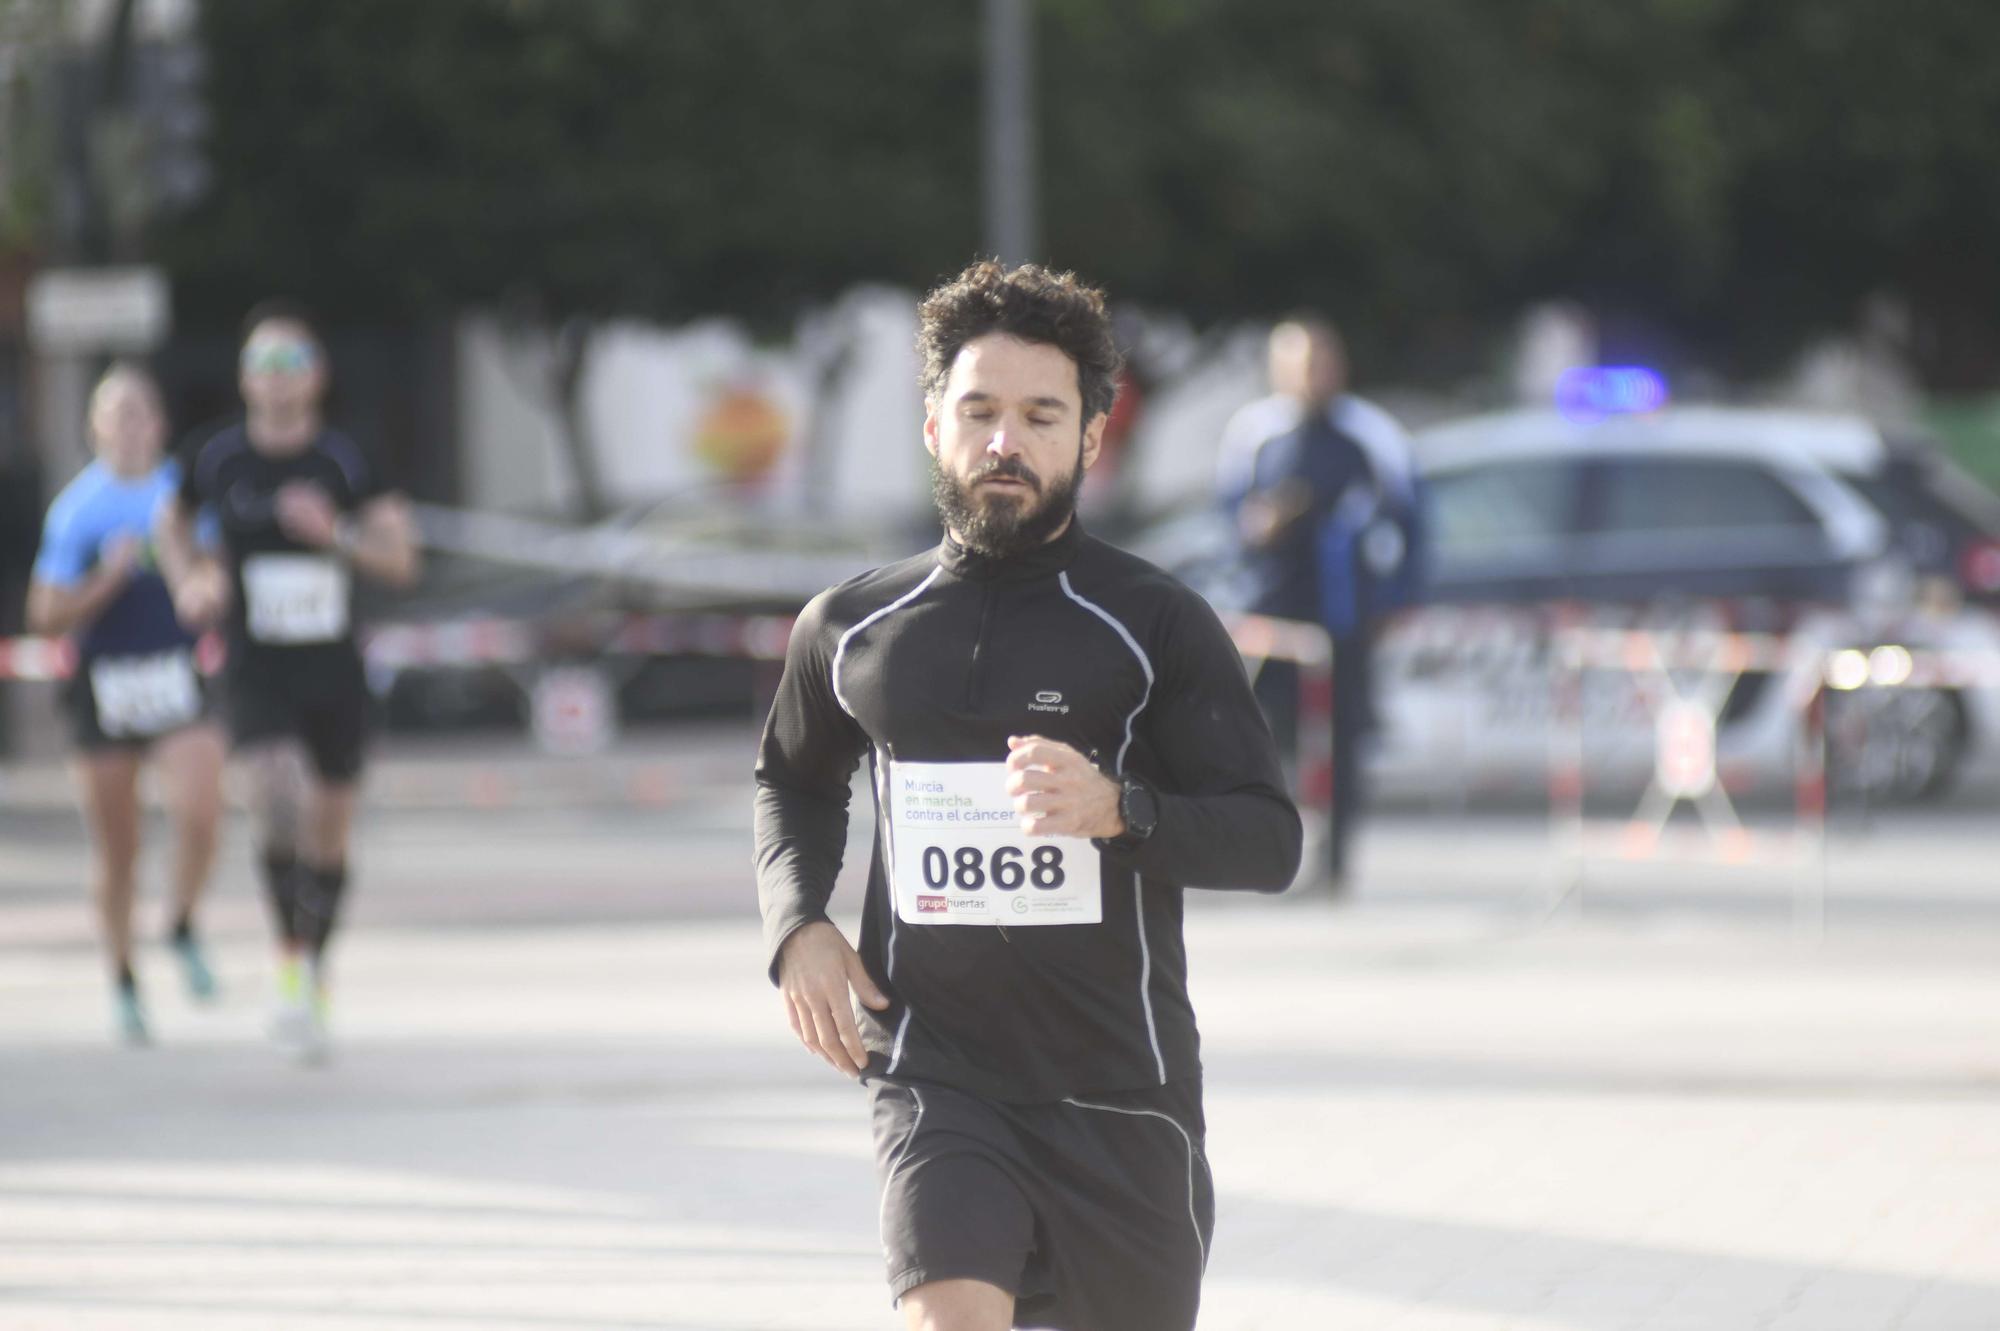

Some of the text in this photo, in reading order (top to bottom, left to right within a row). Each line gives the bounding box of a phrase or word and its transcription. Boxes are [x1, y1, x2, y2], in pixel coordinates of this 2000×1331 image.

[905, 778, 944, 793] Murcia
[905, 794, 973, 807] en marcha
[905, 808, 1016, 822] contra el cáncer
[922, 845, 1066, 891] 0868
